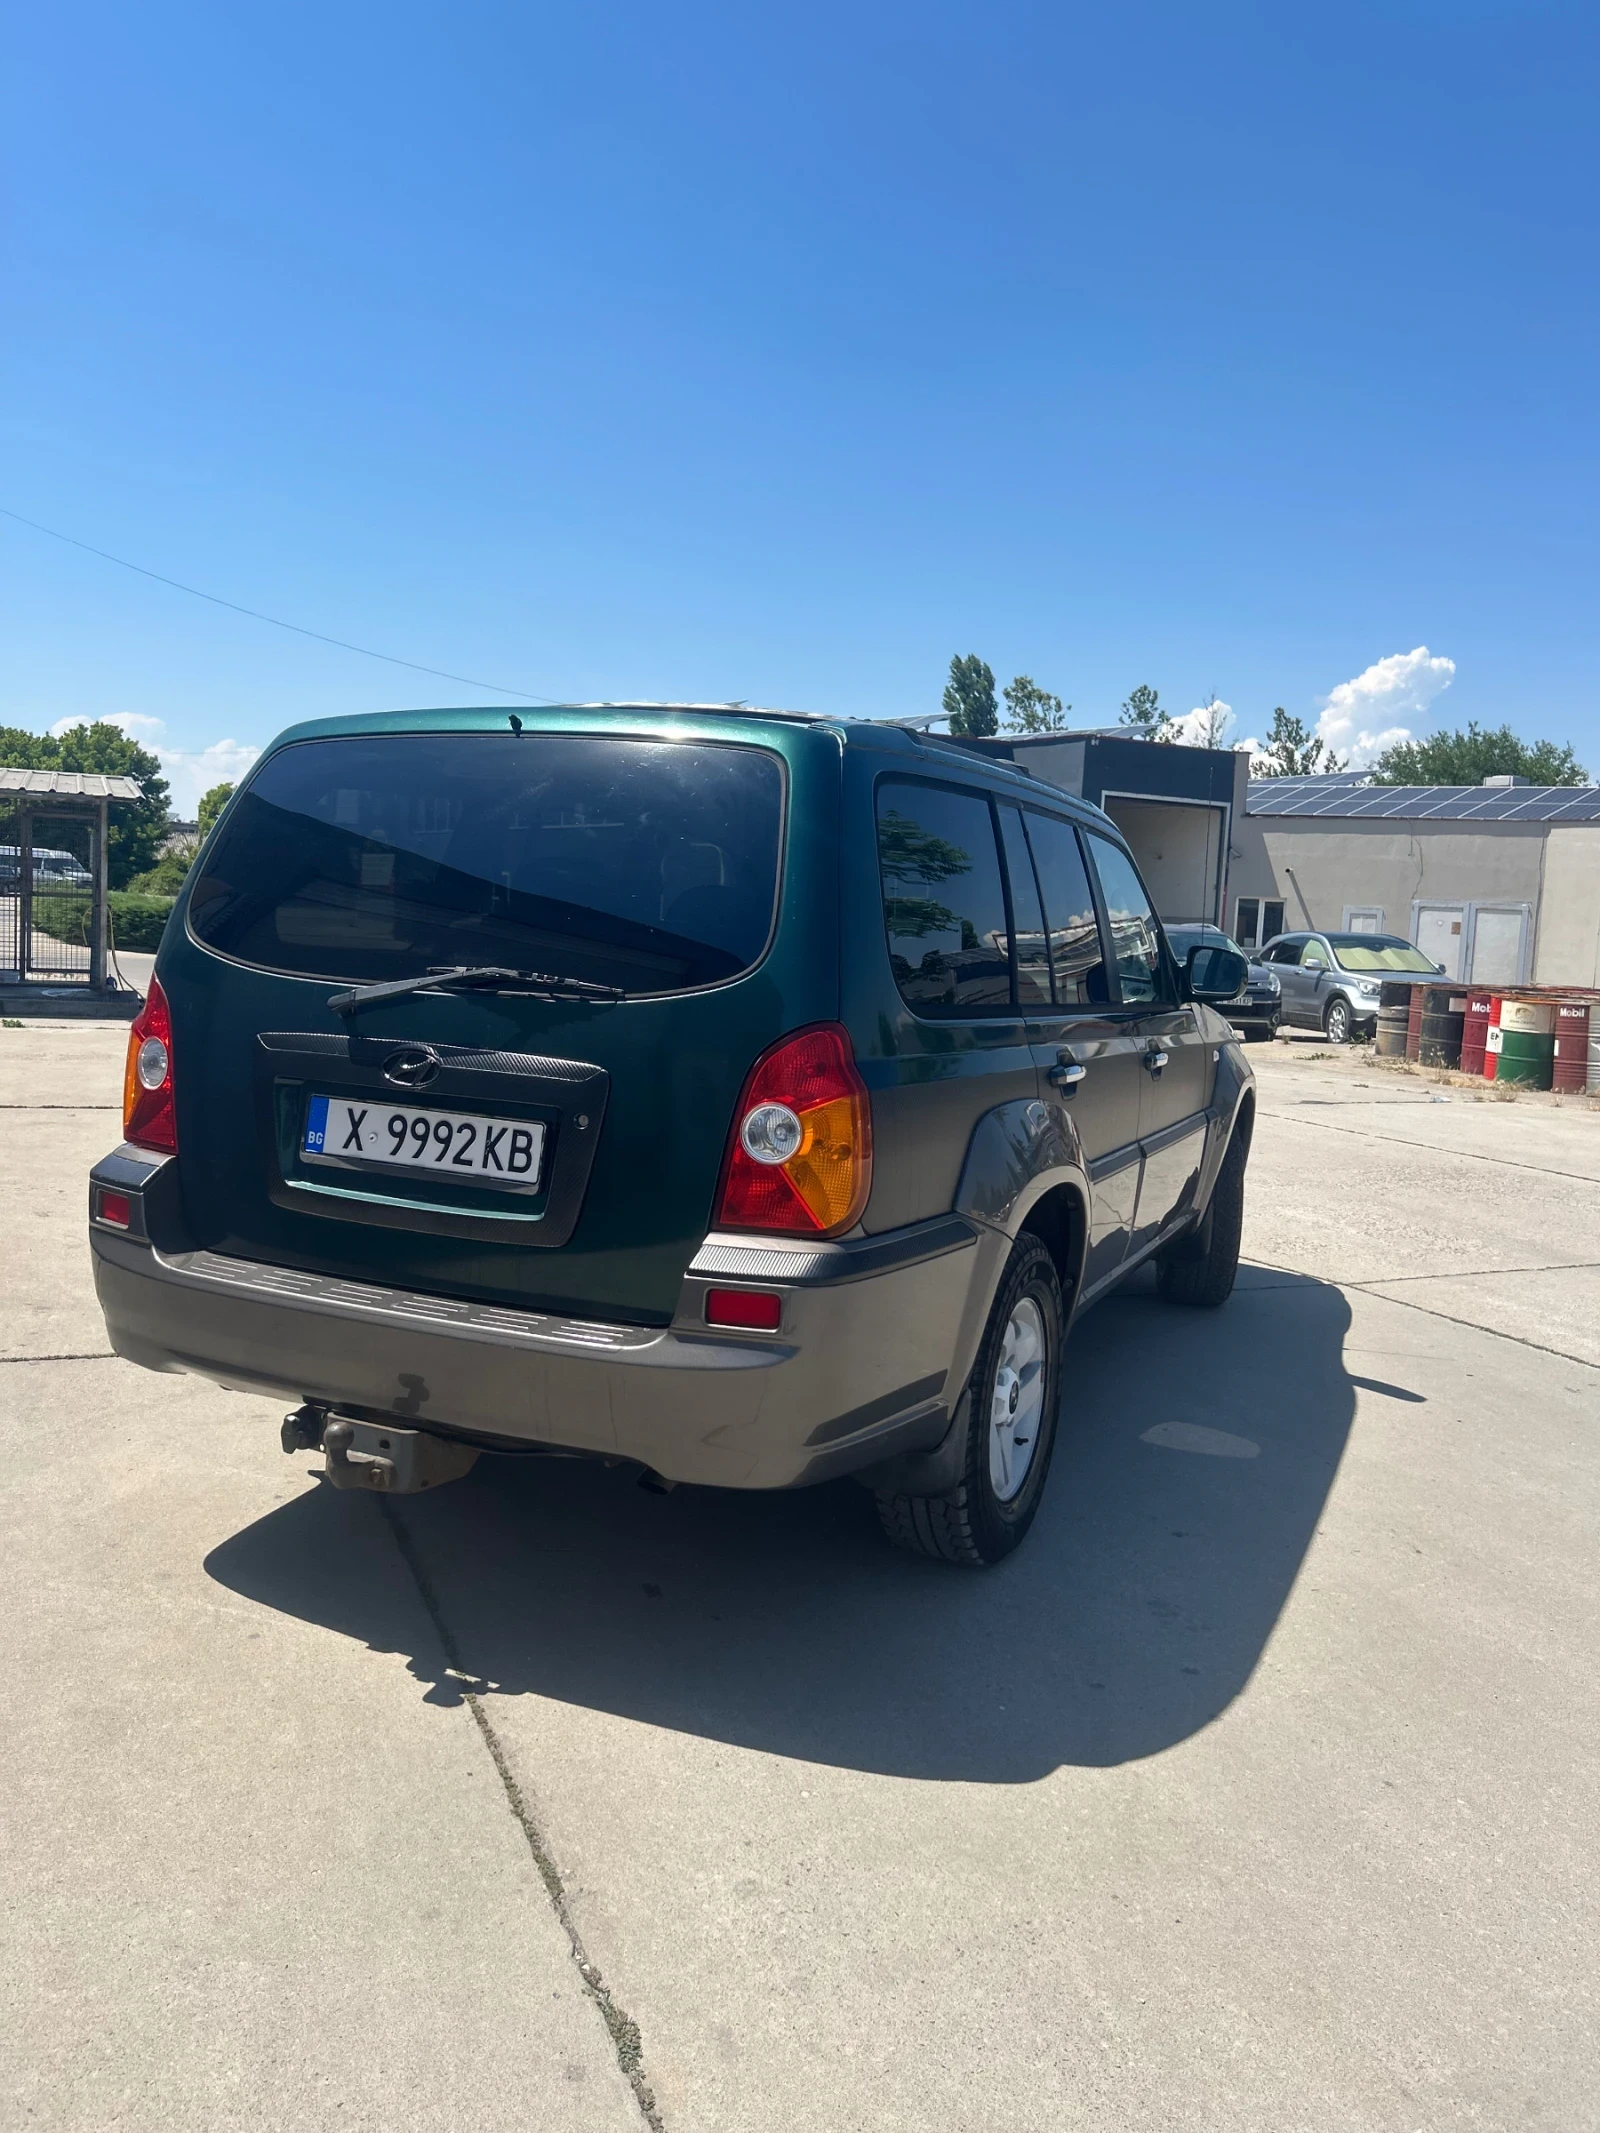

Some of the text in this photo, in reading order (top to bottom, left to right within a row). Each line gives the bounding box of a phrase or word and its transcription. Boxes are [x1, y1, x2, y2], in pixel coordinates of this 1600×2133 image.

[1560, 1007, 1585, 1018] Mobil
[342, 1107, 369, 1152] X
[307, 1130, 325, 1145] BG
